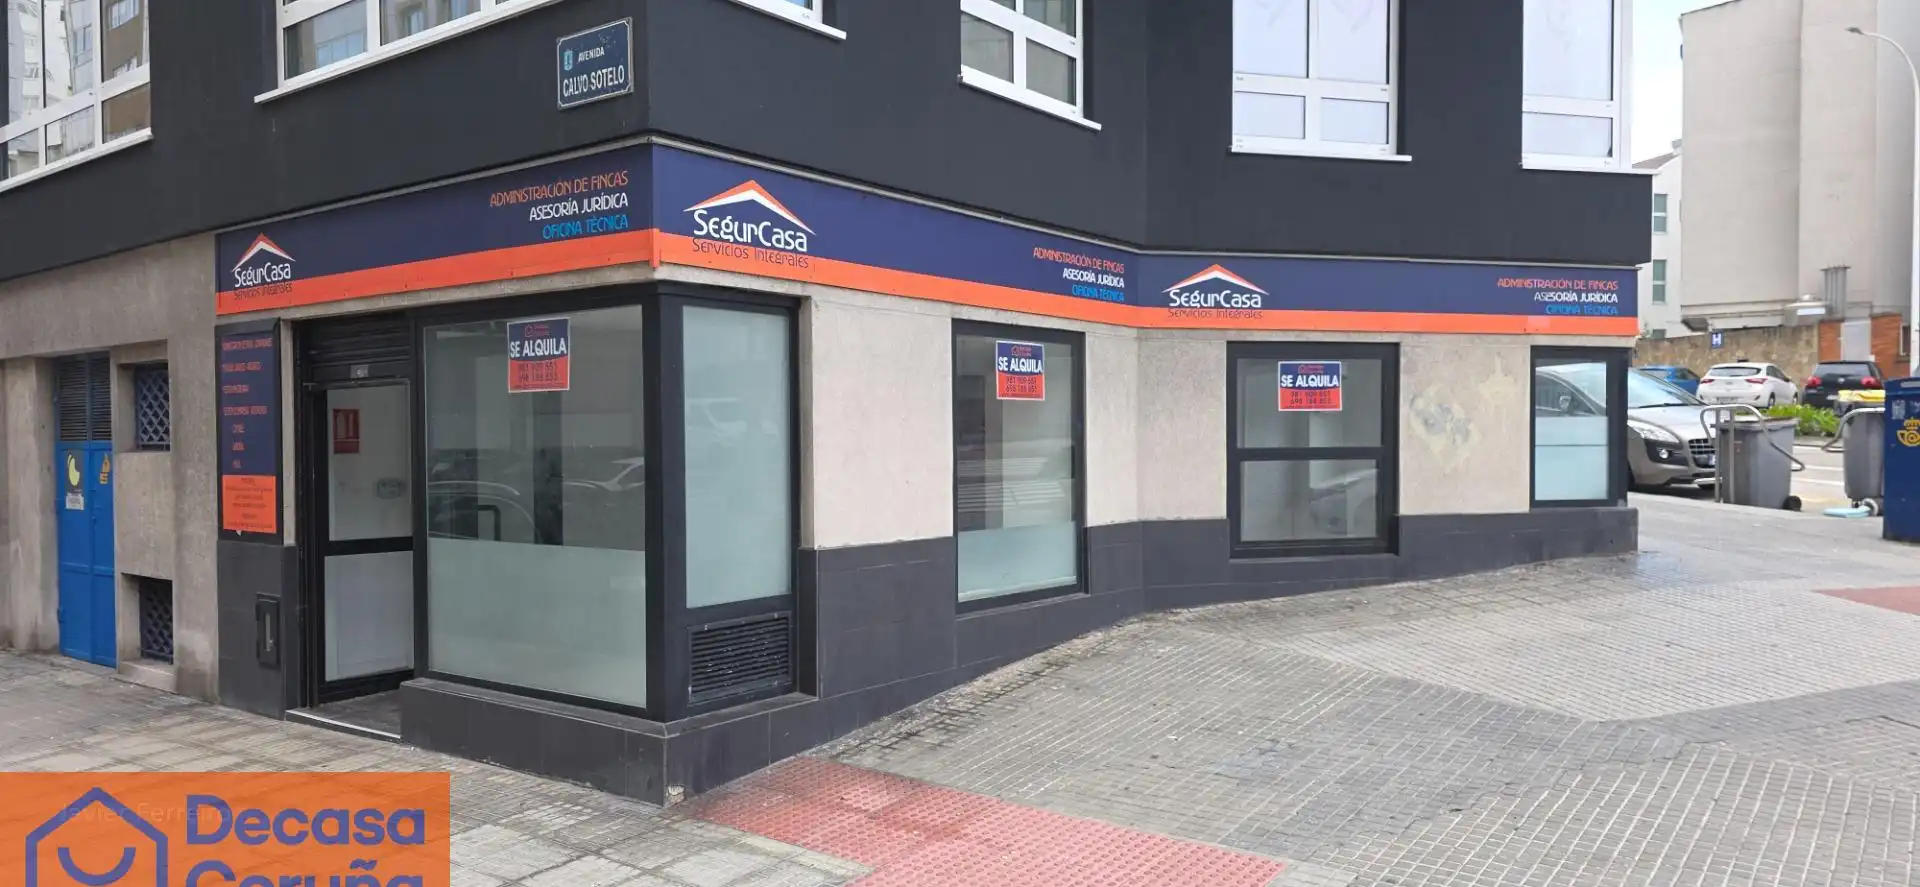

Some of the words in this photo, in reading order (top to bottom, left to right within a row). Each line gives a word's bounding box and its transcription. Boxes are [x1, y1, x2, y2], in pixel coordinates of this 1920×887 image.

[578, 47, 605, 62] AVENIDA
[563, 74, 588, 96] CALVO
[590, 65, 624, 90] SOTELO
[490, 179, 572, 207] ADMINISTRACIÓN
[574, 179, 589, 192] DE
[591, 171, 628, 190] FINCAS
[529, 198, 578, 221] ASESORÍA
[581, 192, 628, 213] JURÍDICA
[542, 220, 582, 239] OFICINA
[586, 215, 628, 233] TÉCNICA
[694, 209, 807, 252] SegurCasa
[692, 239, 749, 259] Servicios
[754, 248, 809, 268] Integrales
[1033, 247, 1092, 268] ADMINISTRACIÓN
[1093, 258, 1102, 269] DE
[1103, 260, 1124, 273] FINCAS
[235, 262, 291, 287] SegurCasa
[1063, 268, 1096, 283] ASESORÍA
[1097, 273, 1124, 288] JURÍDICA
[1497, 278, 1572, 289] ADMINISTRACIÓN
[1574, 280, 1586, 289] DE
[1589, 280, 1618, 290] FINCAS
[1169, 290, 1261, 308] SegurCasa
[1534, 291, 1578, 302] ASESORÍA
[1580, 291, 1618, 303] JURÍDICA
[1168, 308, 1212, 318] Servicios
[510, 341, 520, 357] SE
[523, 338, 567, 356] ALQUILA
[1712, 333, 1721, 345] H
[998, 357, 1008, 371] SE
[1010, 358, 1043, 372] ALQUILA
[1281, 375, 1293, 387] SE
[1296, 375, 1339, 387] ALQUILA
